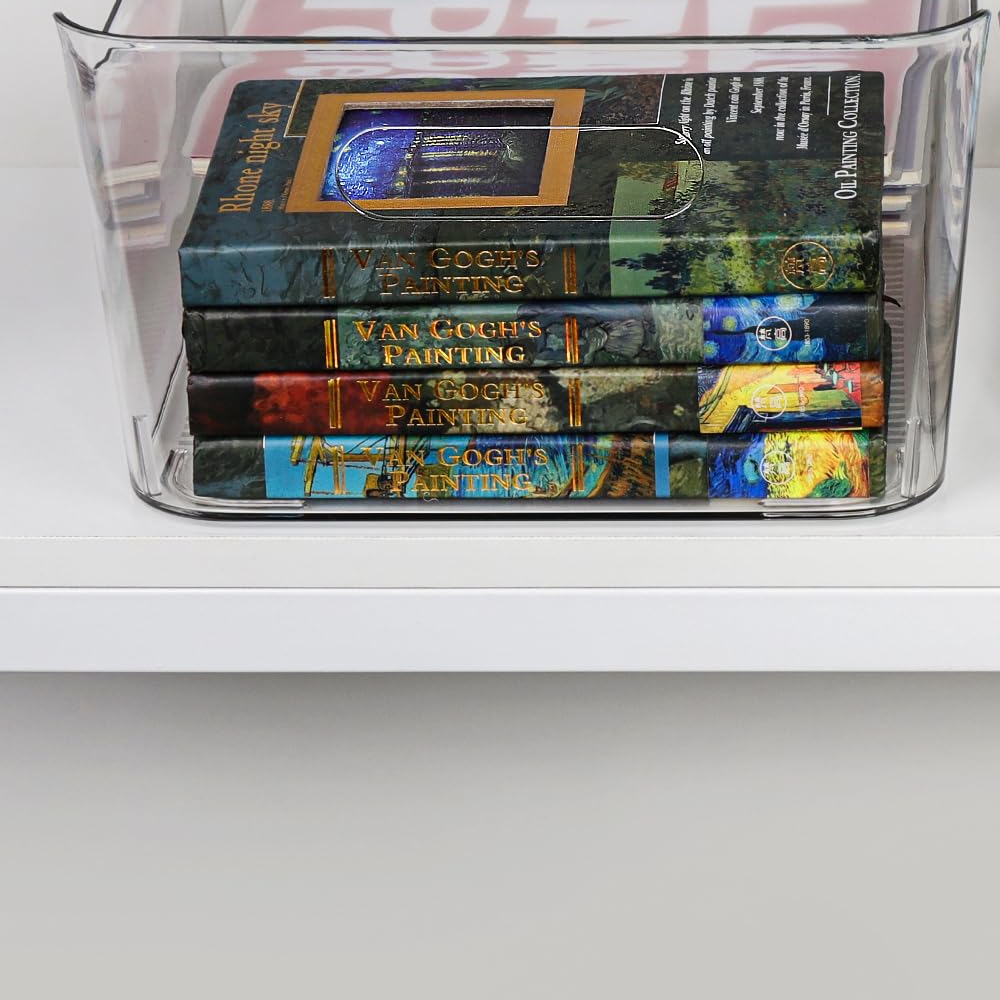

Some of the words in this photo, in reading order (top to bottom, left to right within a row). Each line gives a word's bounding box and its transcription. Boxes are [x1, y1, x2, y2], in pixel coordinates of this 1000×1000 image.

[703, 93, 716, 108] Dutch
[750, 87, 765, 114] September
[774, 88, 788, 112] collection
[246, 102, 293, 123] sky
[725, 104, 738, 123] Vincent
[701, 115, 716, 139] painting
[236, 127, 281, 164] night
[834, 130, 858, 179] PAINTING
[218, 168, 263, 213] Rhone
[833, 179, 858, 200] OIL
[350, 249, 417, 271] VAN
[378, 273, 525, 296] PAINTING
[352, 320, 419, 342] VAN
[429, 318, 543, 341] GOGH'S
[381, 344, 526, 367] PAINTING
[356, 380, 422, 402] VAN
[434, 379, 545, 401] GOGH'S
[384, 405, 528, 427] PAINTING
[360, 447, 425, 468] VAN
[437, 445, 548, 467] GOGH'S
[389, 471, 532, 493] PAINTING
